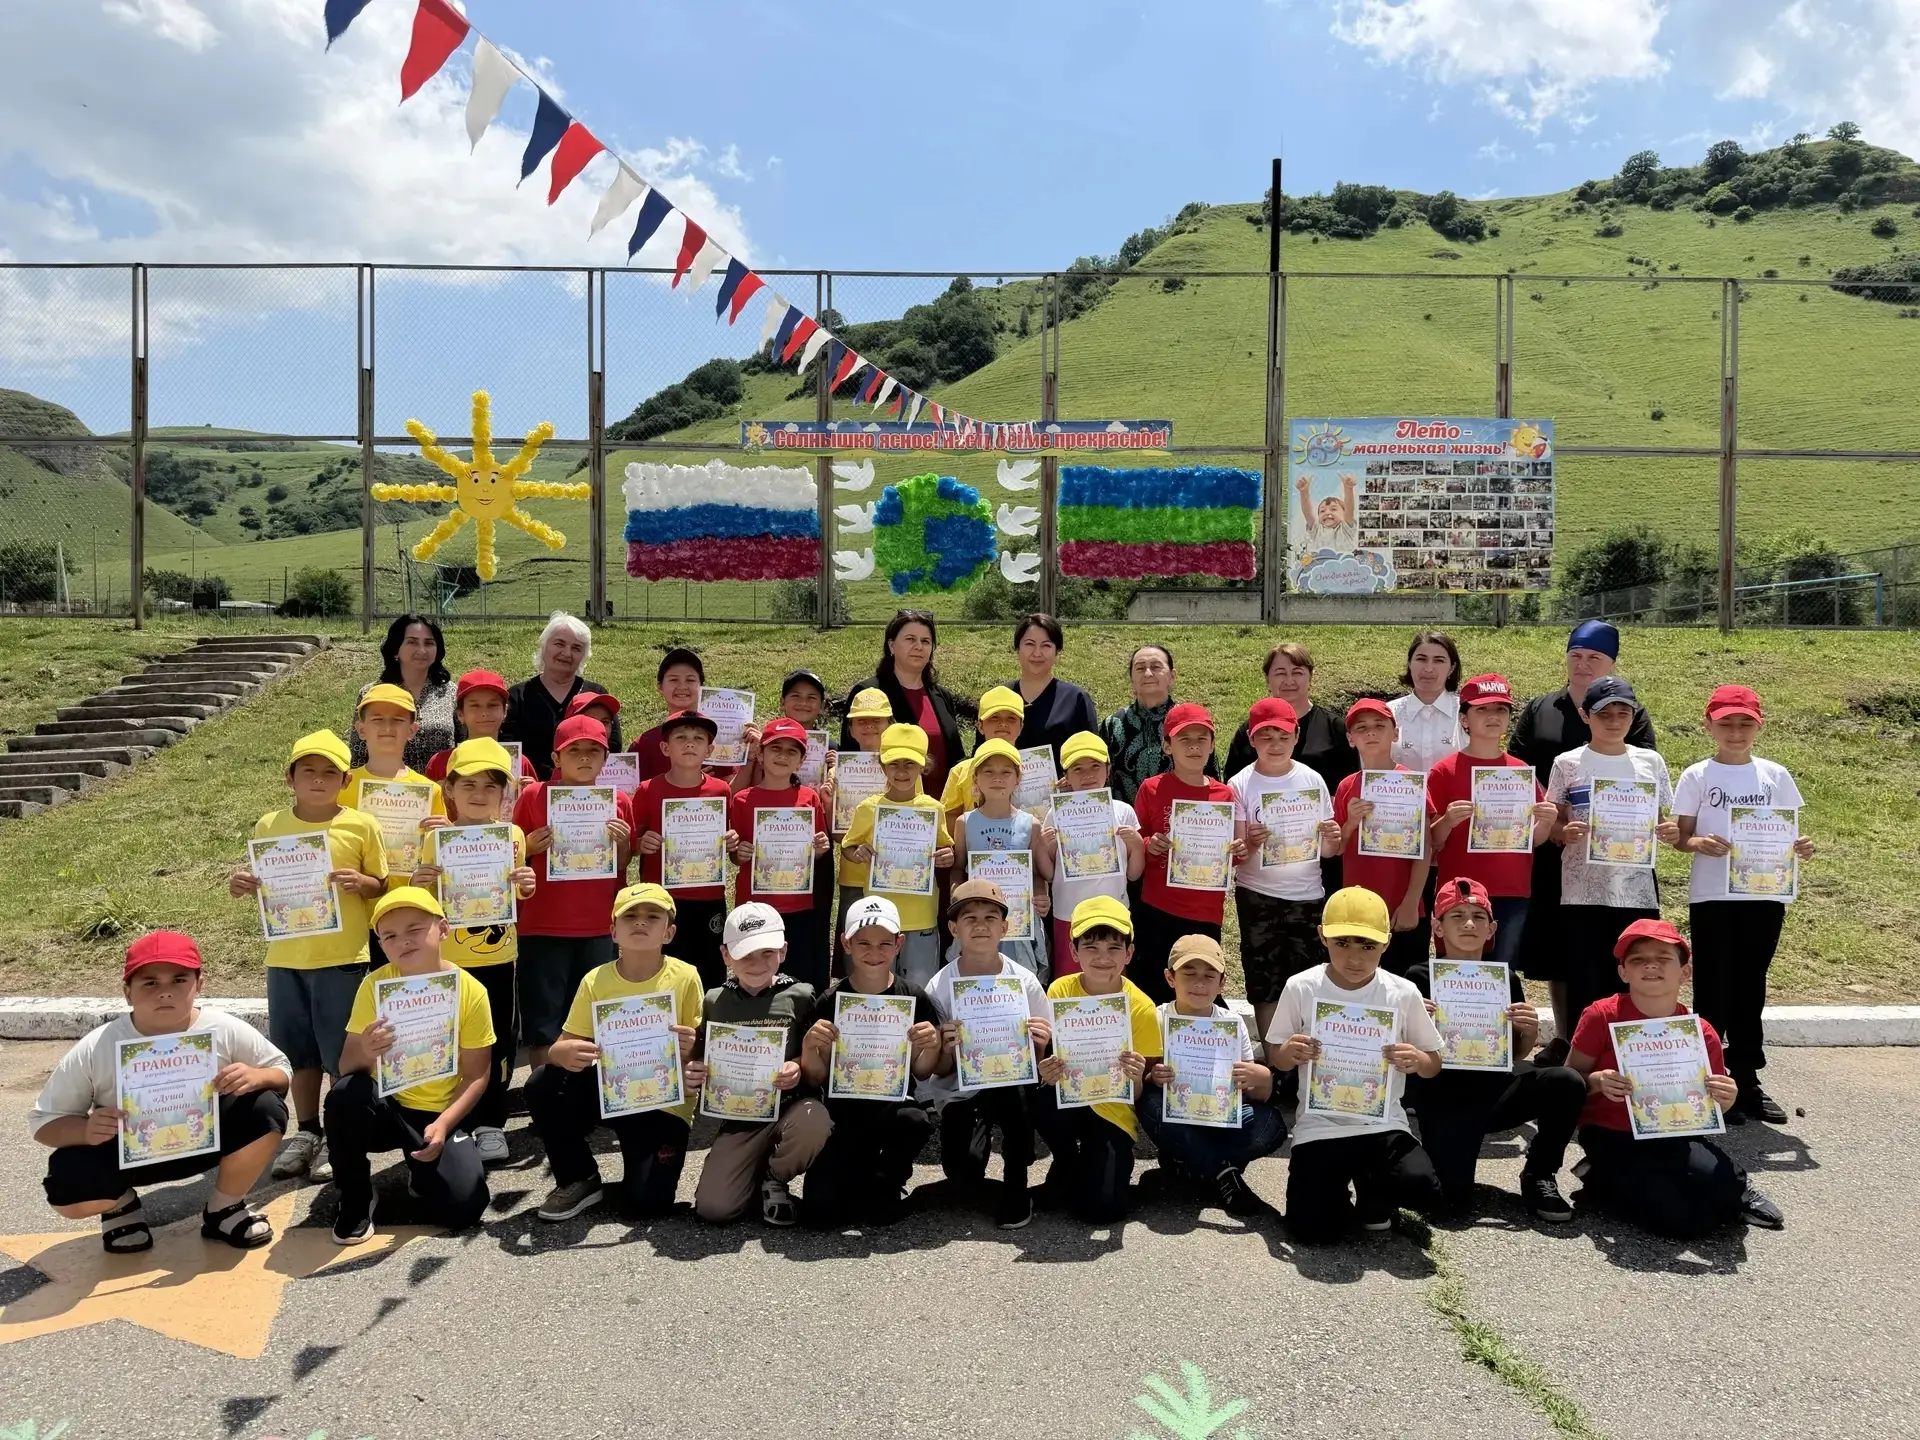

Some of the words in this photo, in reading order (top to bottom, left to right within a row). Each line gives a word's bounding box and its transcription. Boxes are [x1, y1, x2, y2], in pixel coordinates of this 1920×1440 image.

[1394, 420, 1460, 440] Лето
[774, 429, 875, 449] Солнышко
[879, 430, 940, 449] ясное!
[1053, 431, 1168, 451] прекрасное!
[1352, 443, 1446, 456] маленькая
[1449, 441, 1509, 456] жизнь!
[707, 701, 745, 711] ГРАМОТА
[843, 766, 883, 774] ГРАМОТА
[1021, 762, 1045, 771] МОТА
[598, 768, 629, 777] АМОТА
[1371, 785, 1415, 795] ГРАМОТА
[1482, 783, 1525, 791] ГРАМОТА
[370, 797, 419, 809] ГРАМОТА
[1601, 793, 1647, 804] ГРАМОТА
[559, 803, 605, 811] ГРАМОТА
[1062, 805, 1104, 817] ГРАМОТА
[1270, 803, 1312, 814] ГРАМОТА
[672, 814, 716, 823] ГРАМОТА
[1181, 816, 1224, 826] ГРАМОТА
[764, 824, 805, 832] ГРАМОТА
[884, 820, 926, 831] ГРАМОТА
[1740, 822, 1787, 832] ГРАМОТА
[449, 842, 501, 855] ГРАМОТА
[264, 852, 318, 867] ГРАМОТА
[979, 867, 1022, 875] ГРАМОТА
[1443, 980, 1497, 991] ГРАМОТА
[388, 993, 446, 1011] ГРАМОТА
[963, 994, 1015, 1006] ГРАМОТА
[847, 1012, 900, 1024] ГРАМОТА
[1453, 1011, 1489, 1020] «Лучший
[607, 1014, 663, 1031] ГРАМОТА
[1064, 1015, 1118, 1028] ГРАМОТА
[1325, 1021, 1381, 1038] ГРАМОТА
[854, 1042, 889, 1050] «Лучший
[1177, 1034, 1229, 1047] ГРАМОТА
[1628, 1039, 1690, 1053] ГРАМОТА
[718, 1041, 772, 1055] ГРАМОТА
[625, 1050, 651, 1059] «Душа
[133, 1054, 200, 1073] ГРАМОТА
[152, 1092, 184, 1104] «Душа
[141, 1102, 196, 1116] компании»
